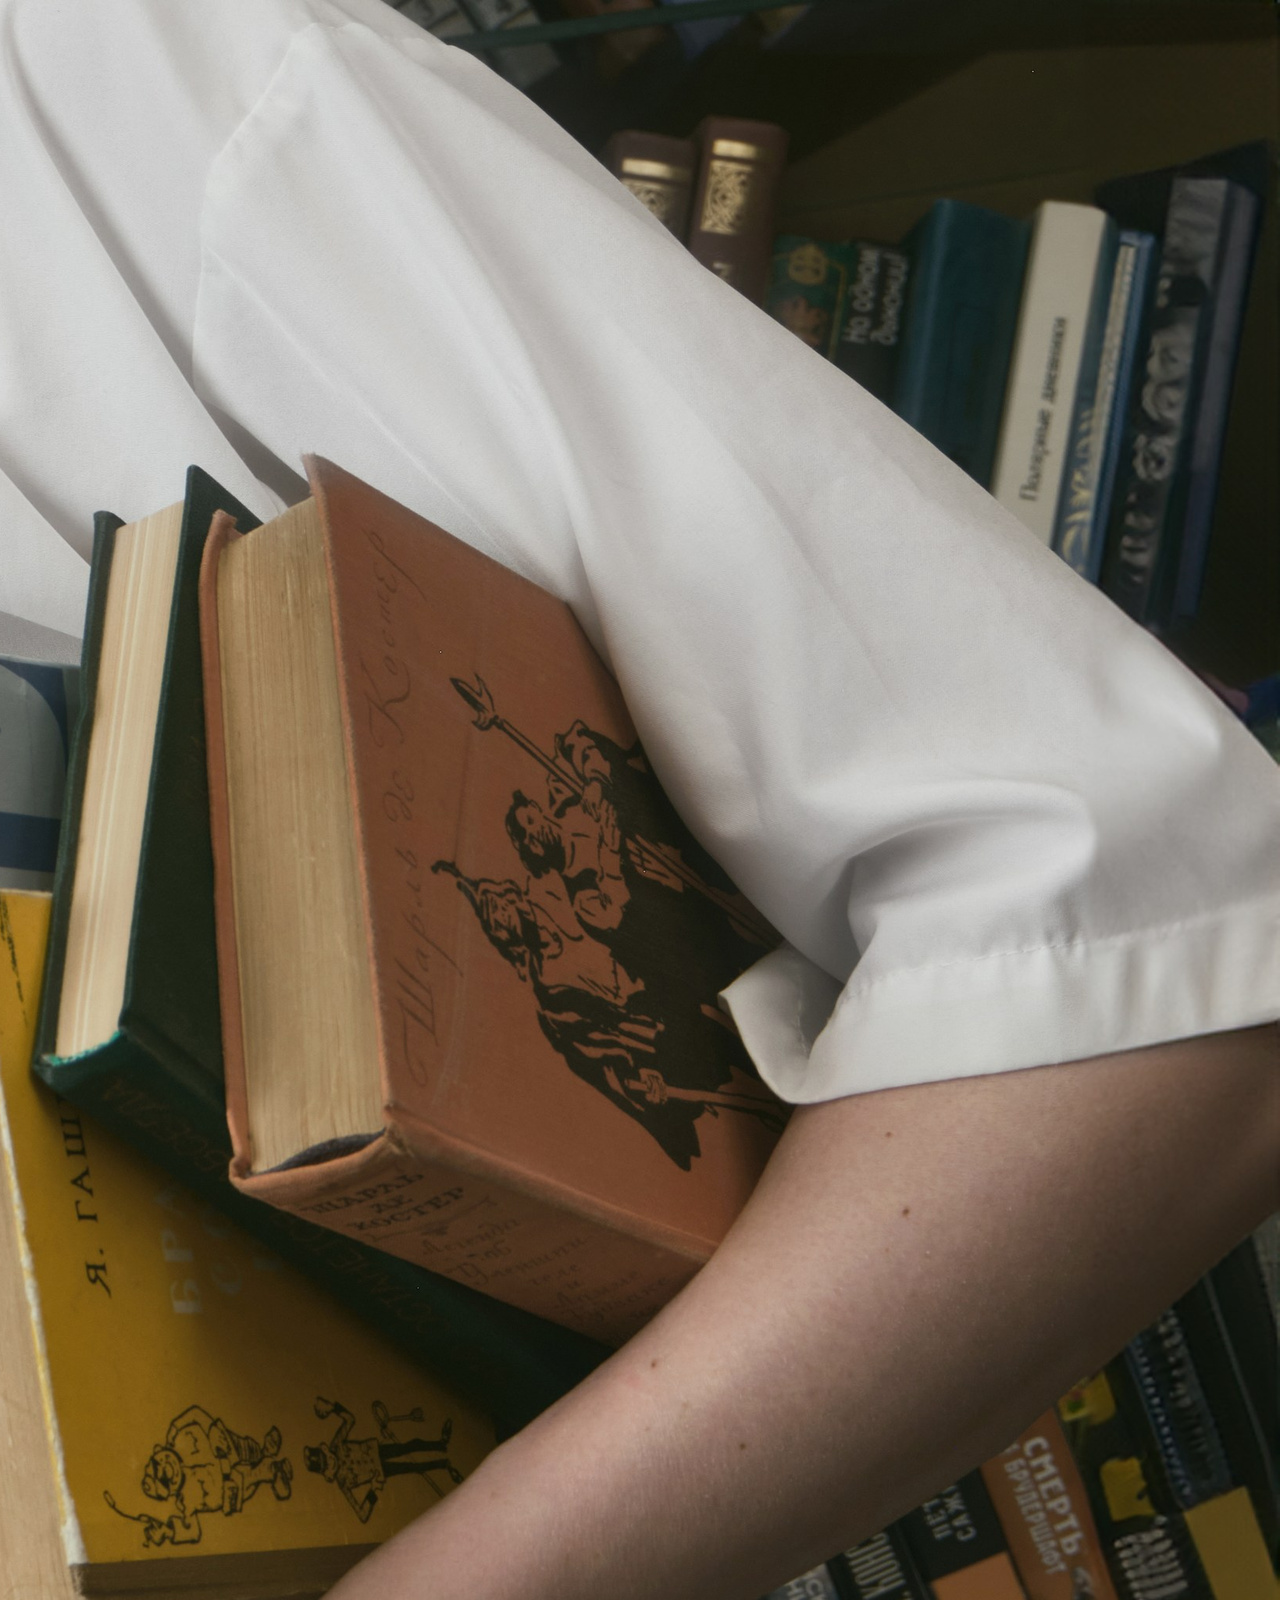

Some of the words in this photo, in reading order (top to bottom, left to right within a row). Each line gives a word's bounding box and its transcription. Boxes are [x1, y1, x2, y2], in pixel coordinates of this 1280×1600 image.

[1019, 407, 1051, 501] Полярные
[1042, 316, 1066, 403] дневники
[361, 529, 428, 748] Костер
[381, 770, 417, 824] де
[392, 848, 464, 1088] Шарль
[60, 1117, 99, 1222] ГАШ
[299, 1173, 424, 1214] ШАРЛЬ
[346, 1186, 464, 1231] КОСТЕР
[371, 1194, 412, 1214] ДЕ
[85, 1248, 113, 1300] Я.
[152, 1185, 204, 1315] БРА
[941, 1485, 977, 1542] САЖ
[1003, 1457, 1069, 1576] БРУДЕРШАФТ
[1022, 1435, 1085, 1557] СМЕРТЬ
[843, 1531, 907, 1600] КОНС
